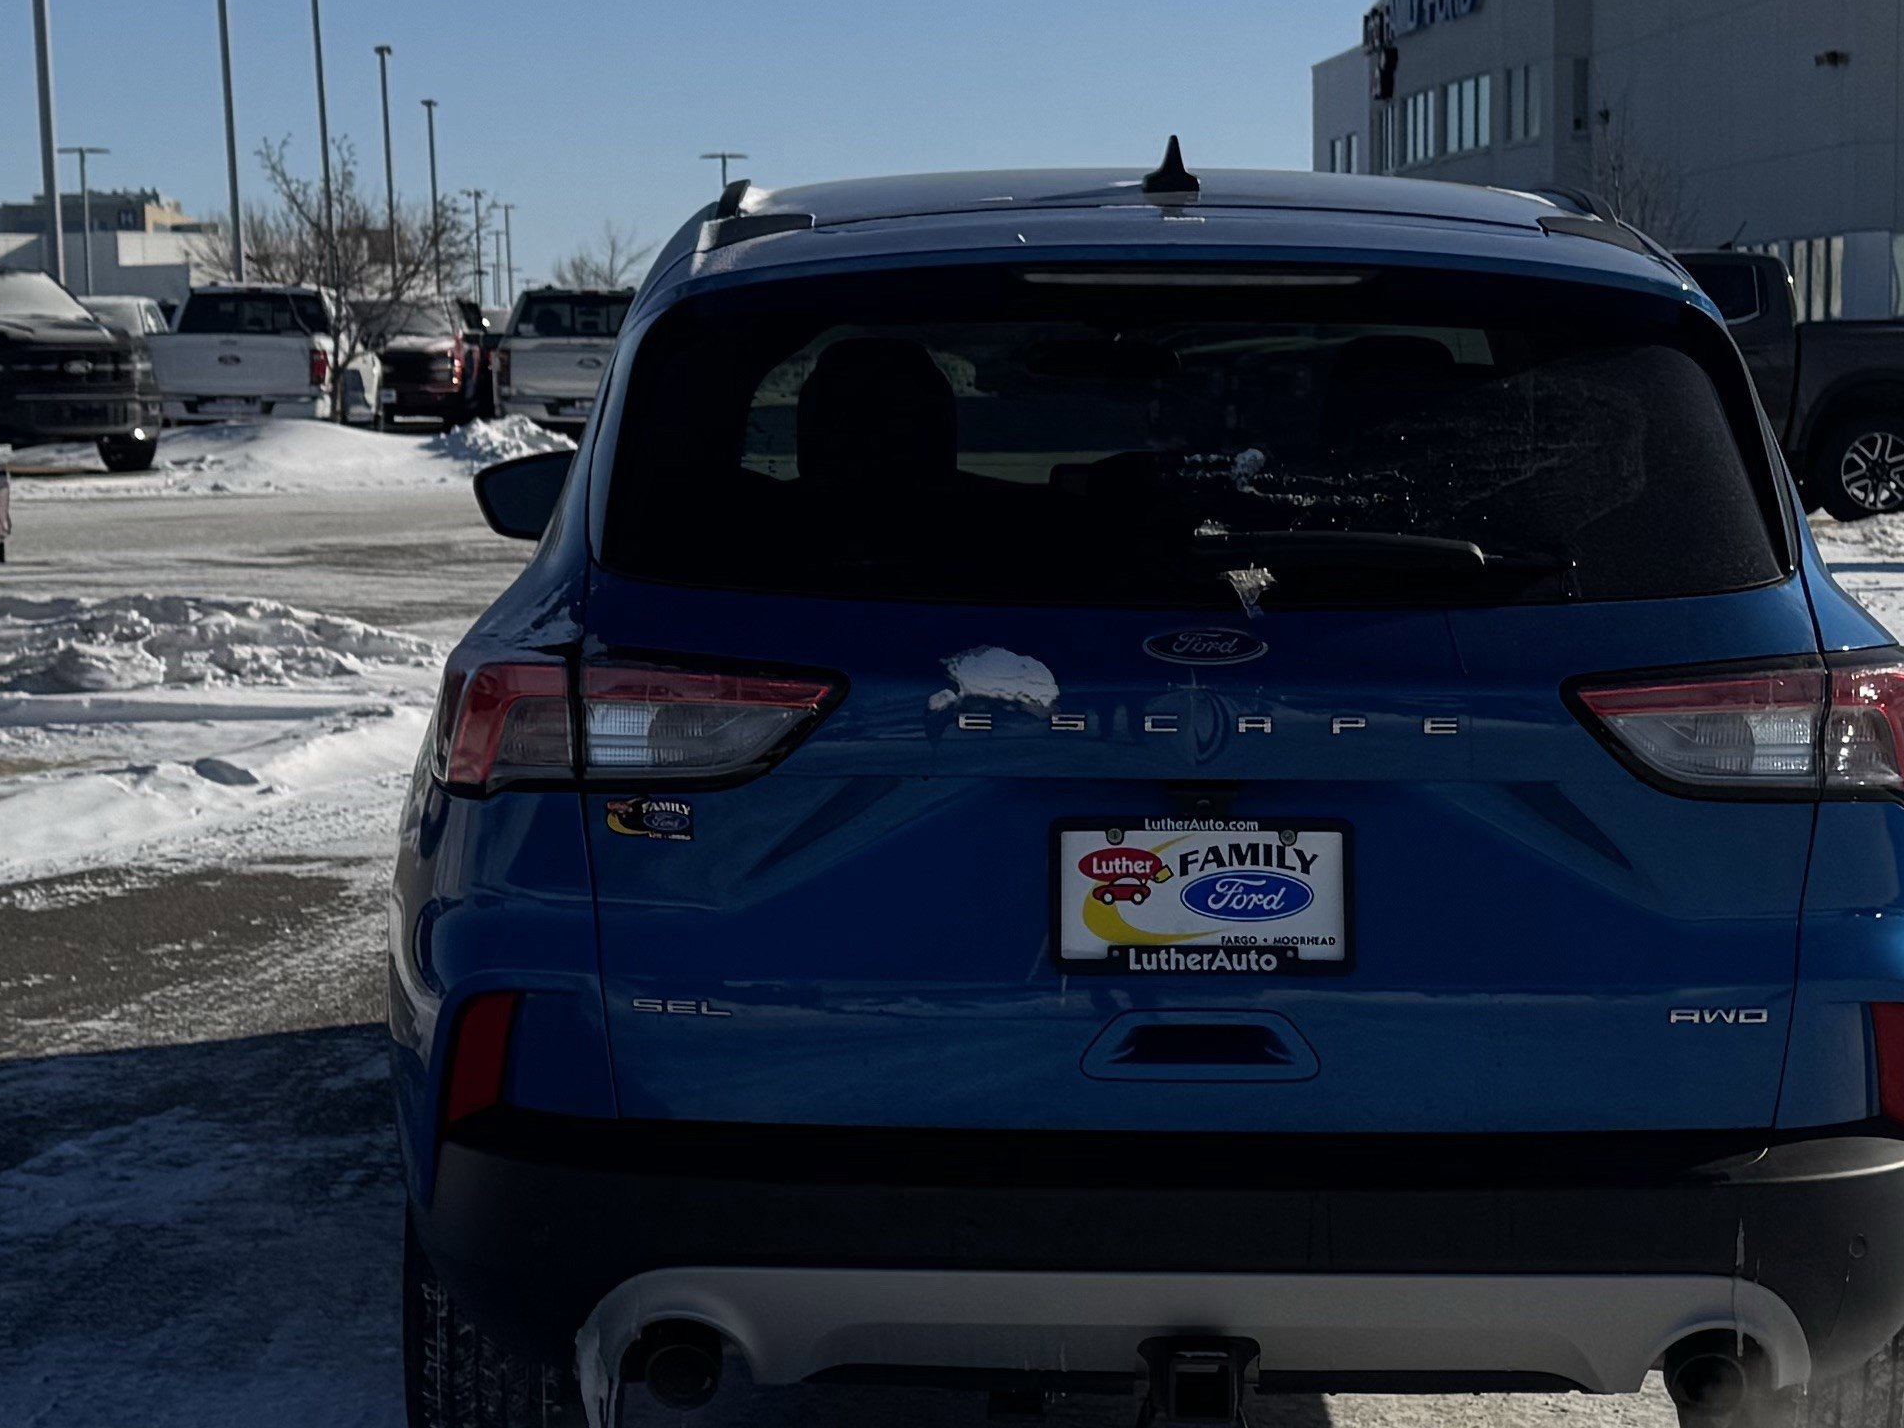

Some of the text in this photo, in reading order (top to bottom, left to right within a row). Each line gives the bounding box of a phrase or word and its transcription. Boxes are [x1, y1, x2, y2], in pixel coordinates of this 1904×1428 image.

[1171, 630, 1239, 656] Ford
[958, 712, 1459, 736] ESCAPE
[641, 801, 691, 815] FAMILY
[1144, 818, 1259, 832] LutherAuto.com
[1092, 857, 1153, 875] Luther
[1179, 842, 1319, 877] FAMILY
[1207, 878, 1285, 910] Ford
[1221, 936, 1336, 946] FARGO MOORHEAD
[1129, 948, 1278, 972] LutherAuto
[633, 998, 732, 1016] SEL
[1670, 1008, 1768, 1024] AWD
